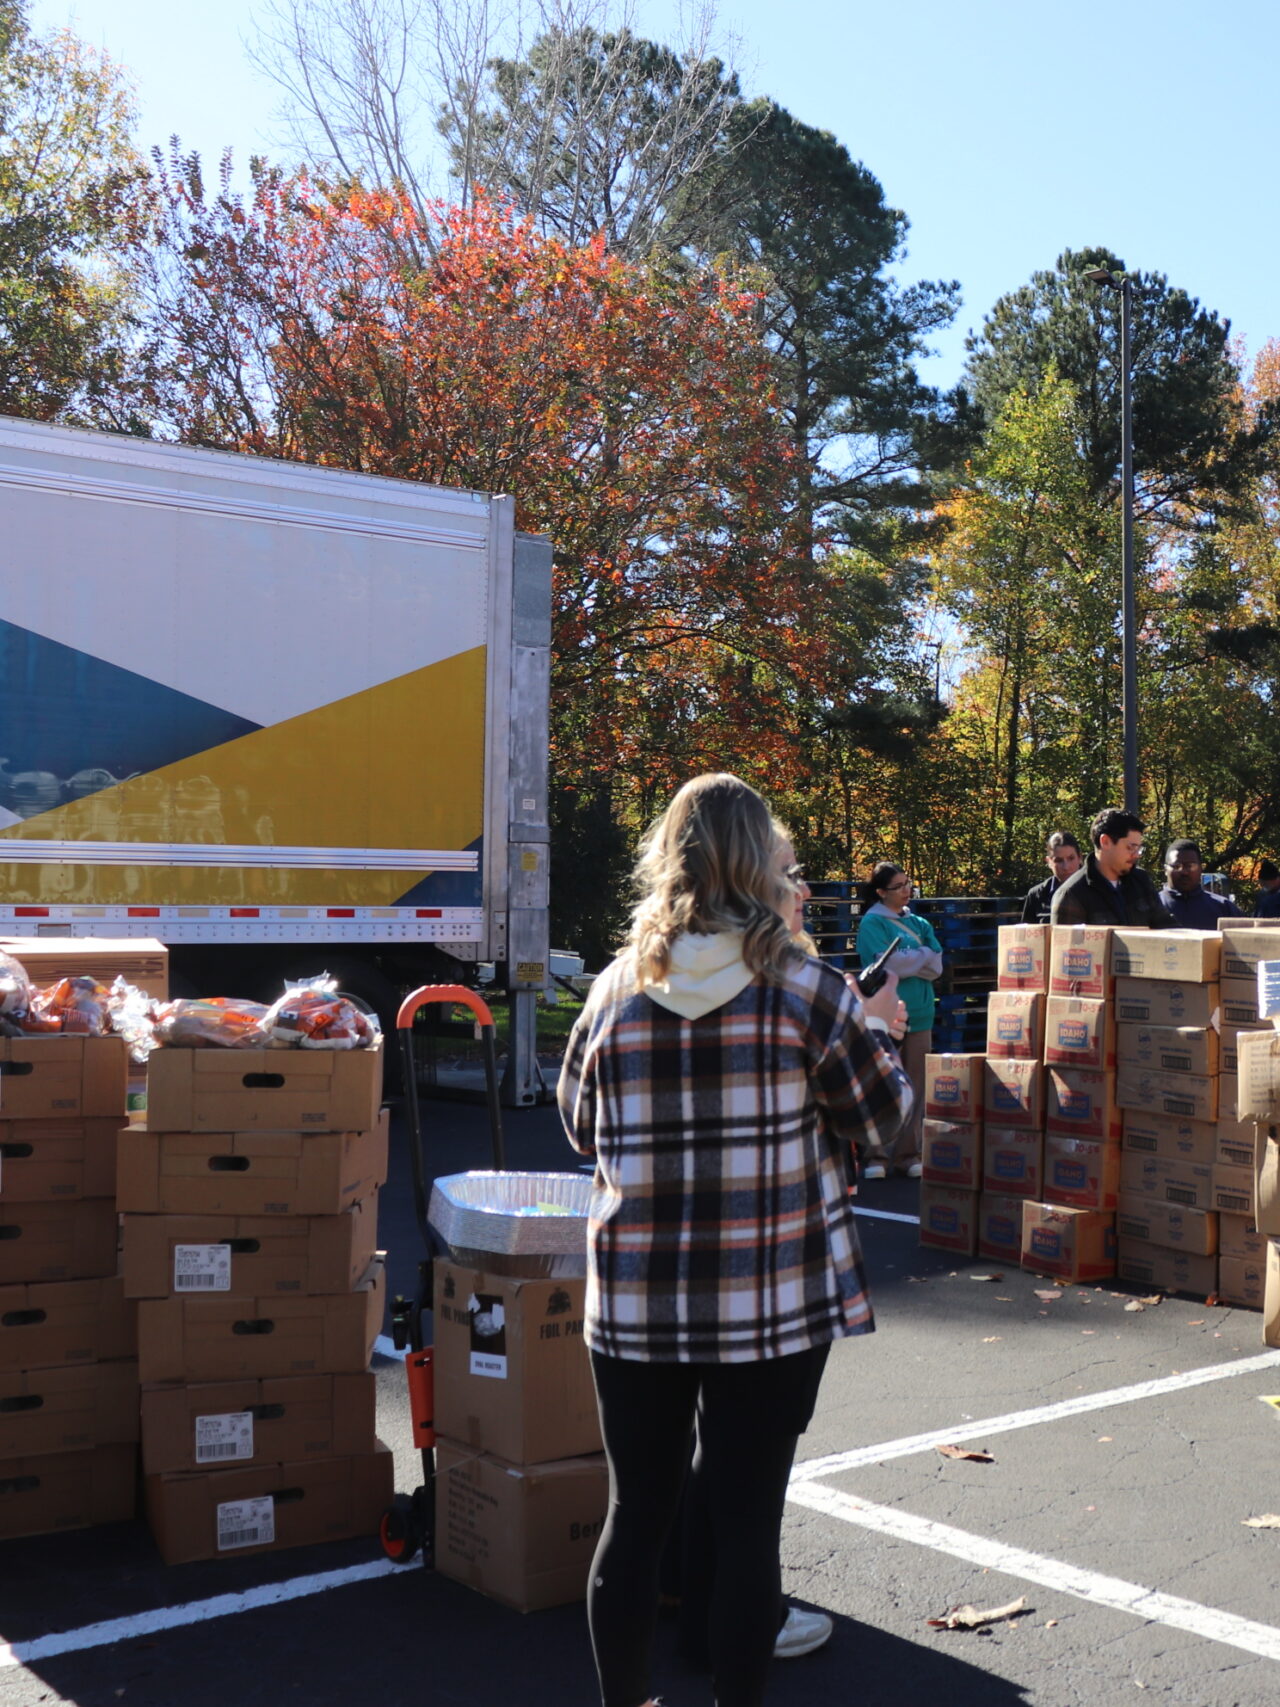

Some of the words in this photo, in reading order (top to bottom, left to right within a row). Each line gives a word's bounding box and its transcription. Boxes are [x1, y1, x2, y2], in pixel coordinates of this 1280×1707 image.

[1008, 955, 1031, 965] IDAHO
[1064, 957, 1089, 967] IDAHO
[998, 1021, 1021, 1032] IDAHO
[1060, 1027, 1086, 1039] IDAHO
[935, 1083, 957, 1093] IDAHO
[996, 1158, 1022, 1170] IDAHO
[1057, 1167, 1082, 1179] IDAHO
[1032, 1233, 1058, 1248] IDAHO
[540, 1322, 560, 1340] FOIL
[565, 1319, 585, 1337] PAN
